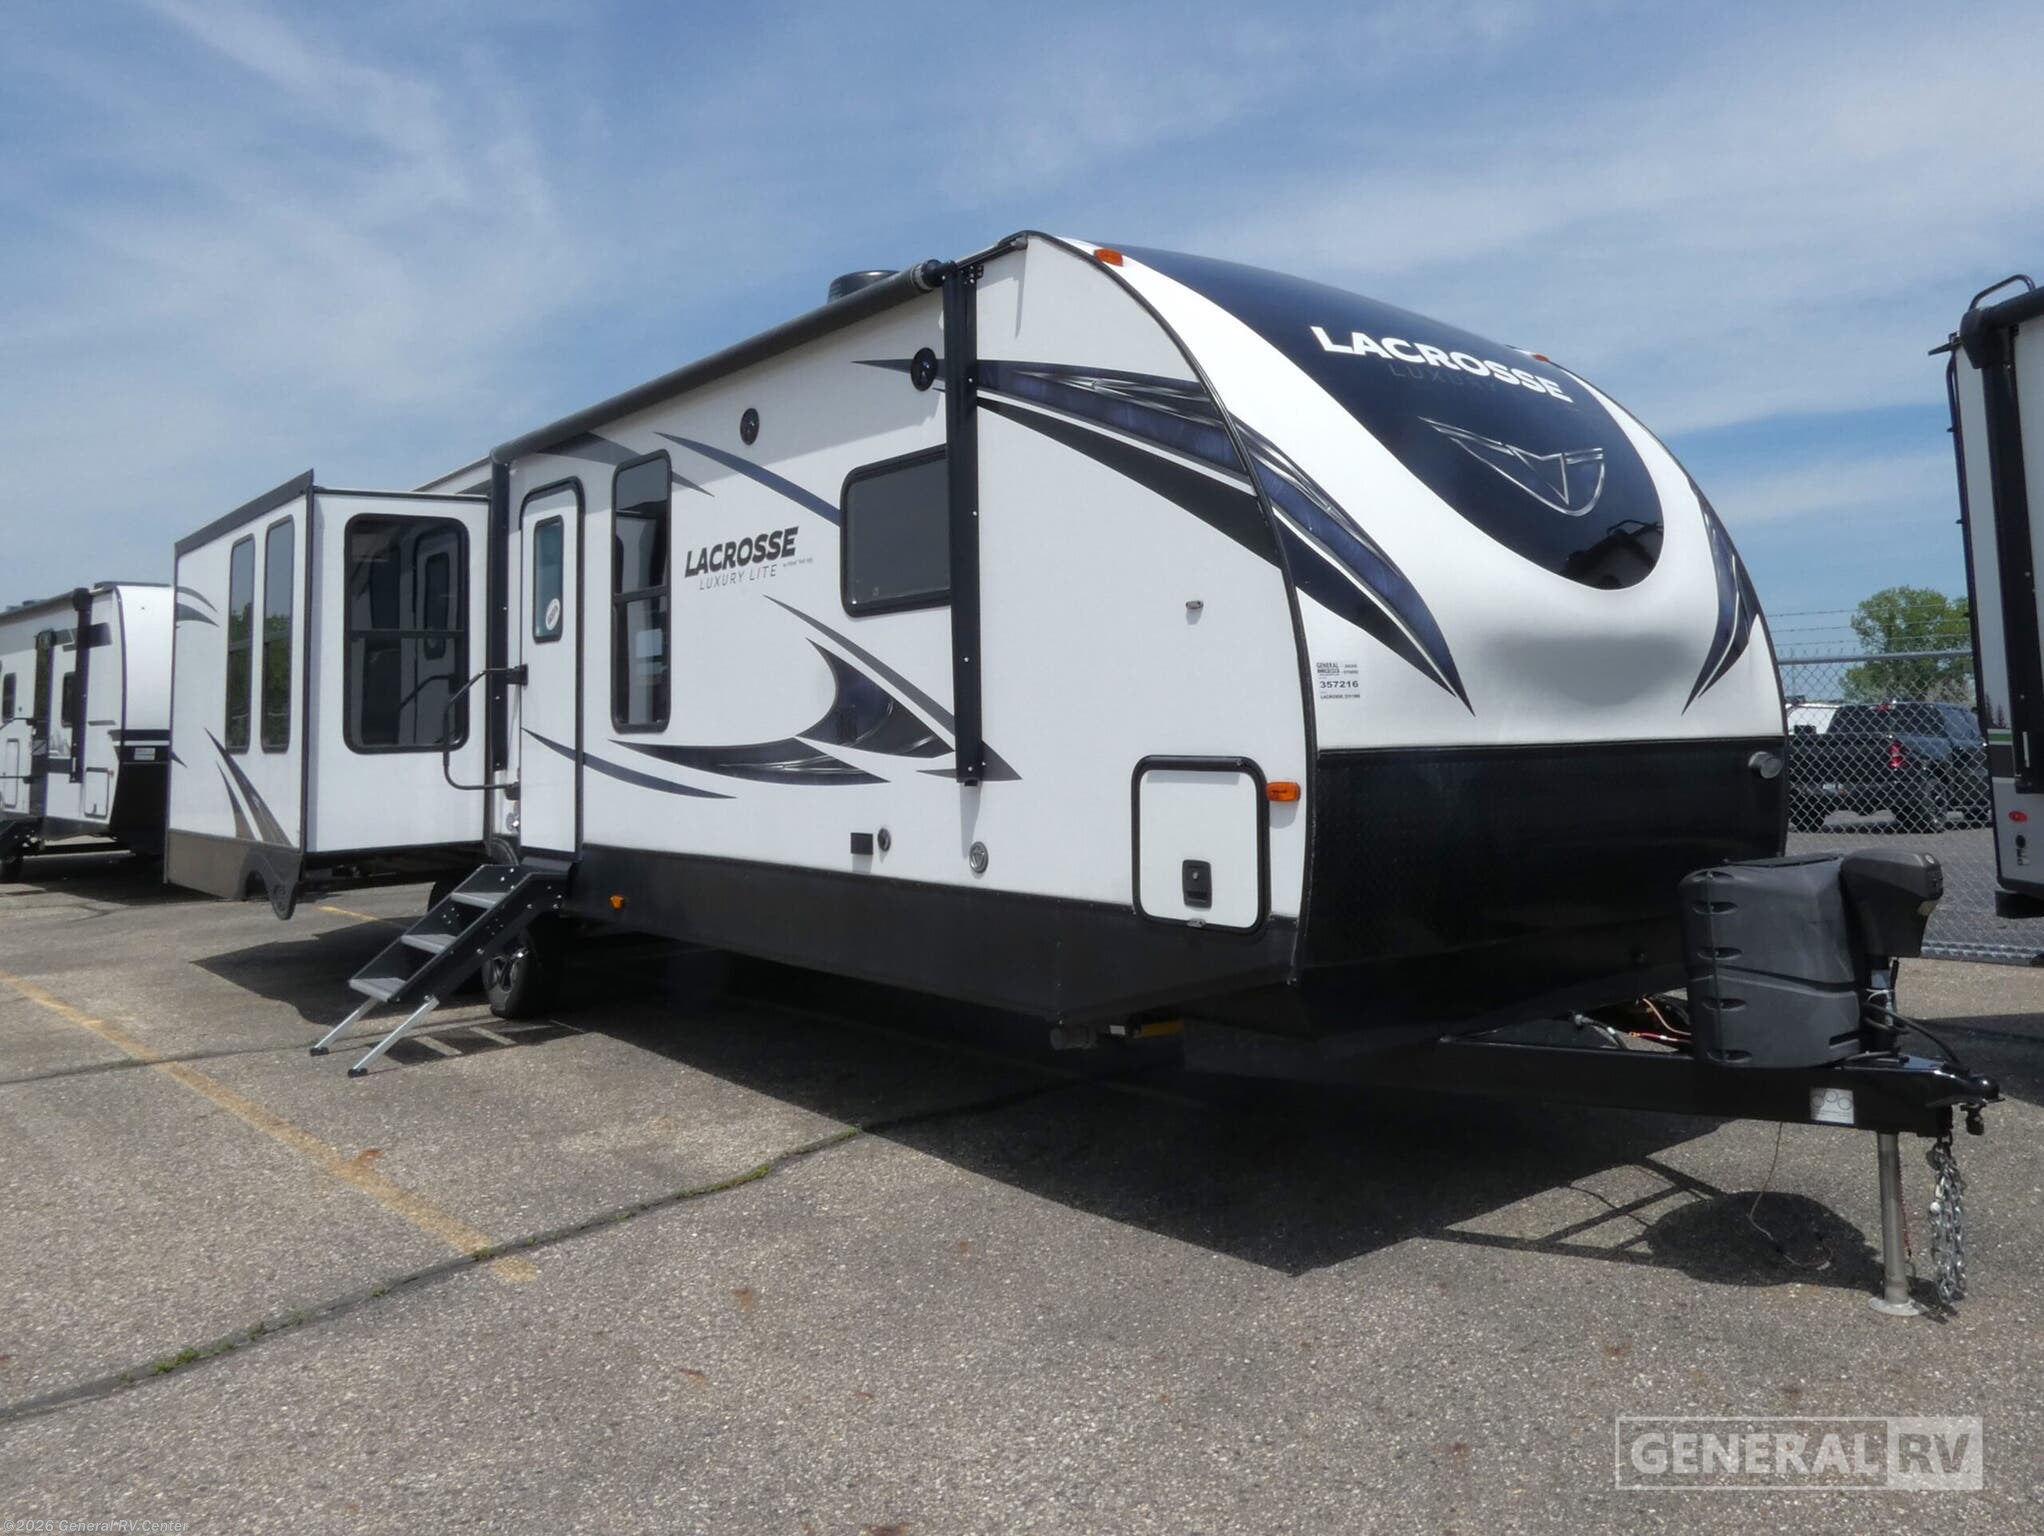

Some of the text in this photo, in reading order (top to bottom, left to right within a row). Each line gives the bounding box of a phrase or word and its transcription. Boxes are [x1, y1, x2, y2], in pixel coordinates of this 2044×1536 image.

[1310, 326, 1574, 404] LACROSSE
[685, 526, 799, 578] LACROSSE
[699, 563, 777, 591] LUXURY LITE
[1320, 680, 1359, 689] 357216
